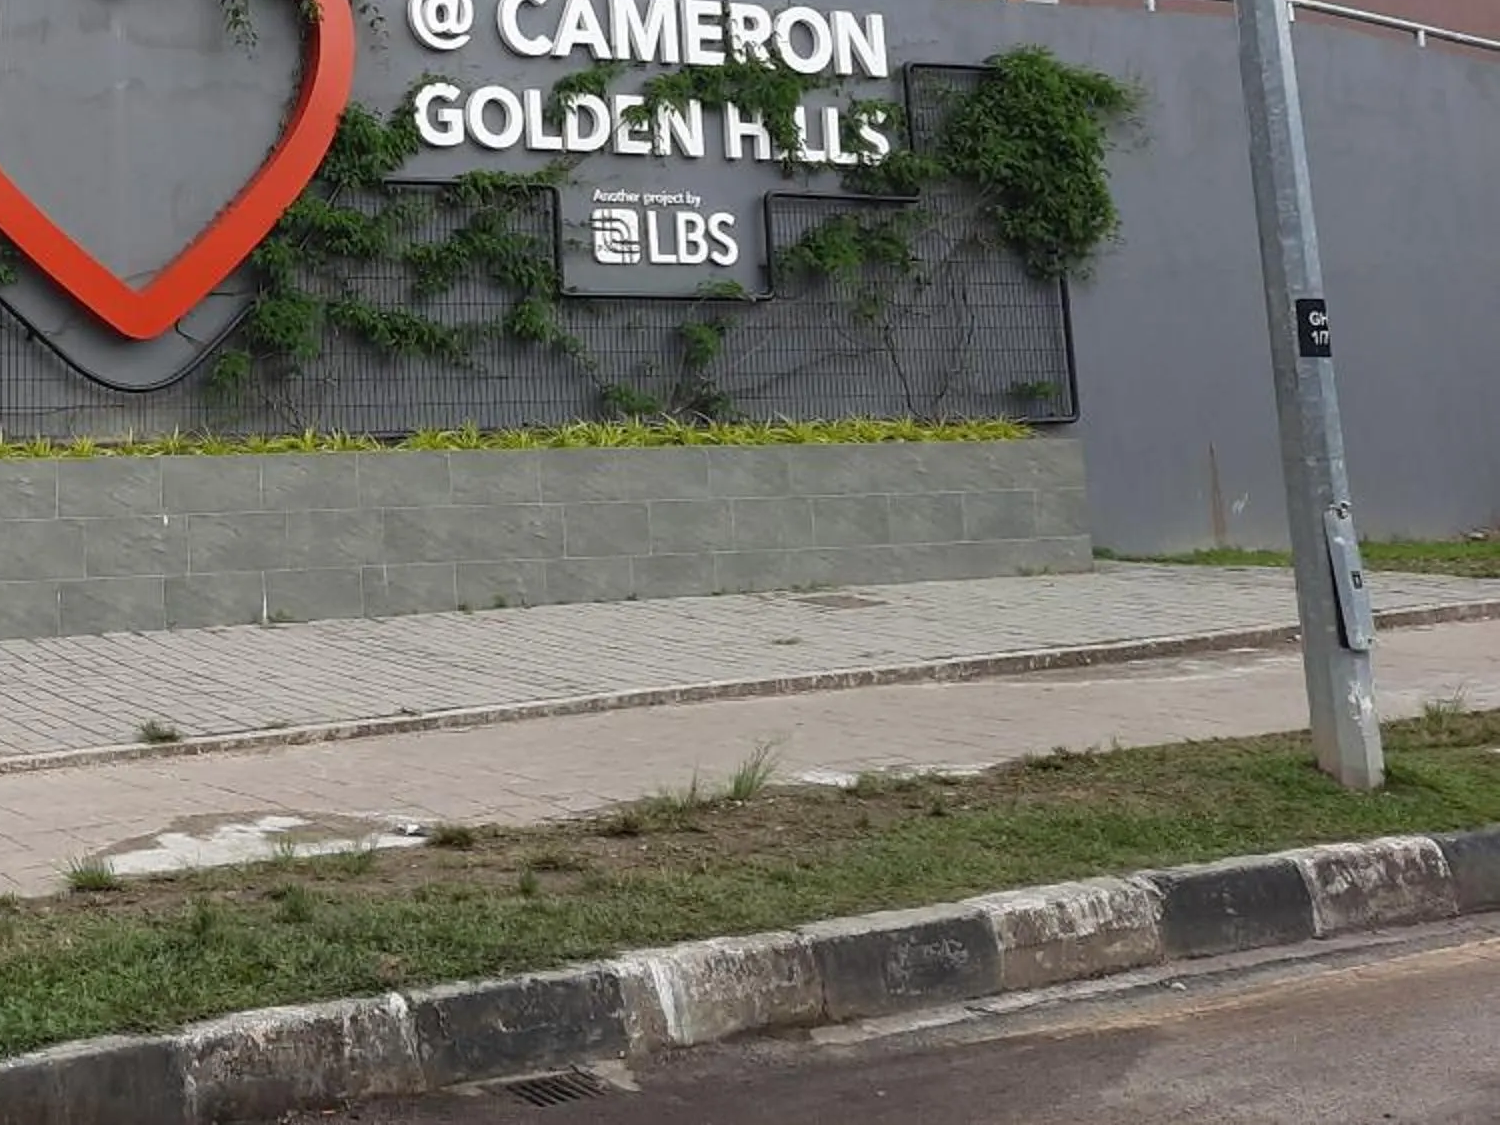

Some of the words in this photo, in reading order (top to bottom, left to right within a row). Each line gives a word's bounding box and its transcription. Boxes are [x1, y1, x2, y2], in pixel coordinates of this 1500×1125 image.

[414, 82, 705, 157] GOLDEN
[723, 102, 892, 166] HLLS
[593, 188, 641, 203] Another
[643, 189, 684, 207] project
[685, 190, 702, 208] by
[647, 210, 739, 266] LBS
